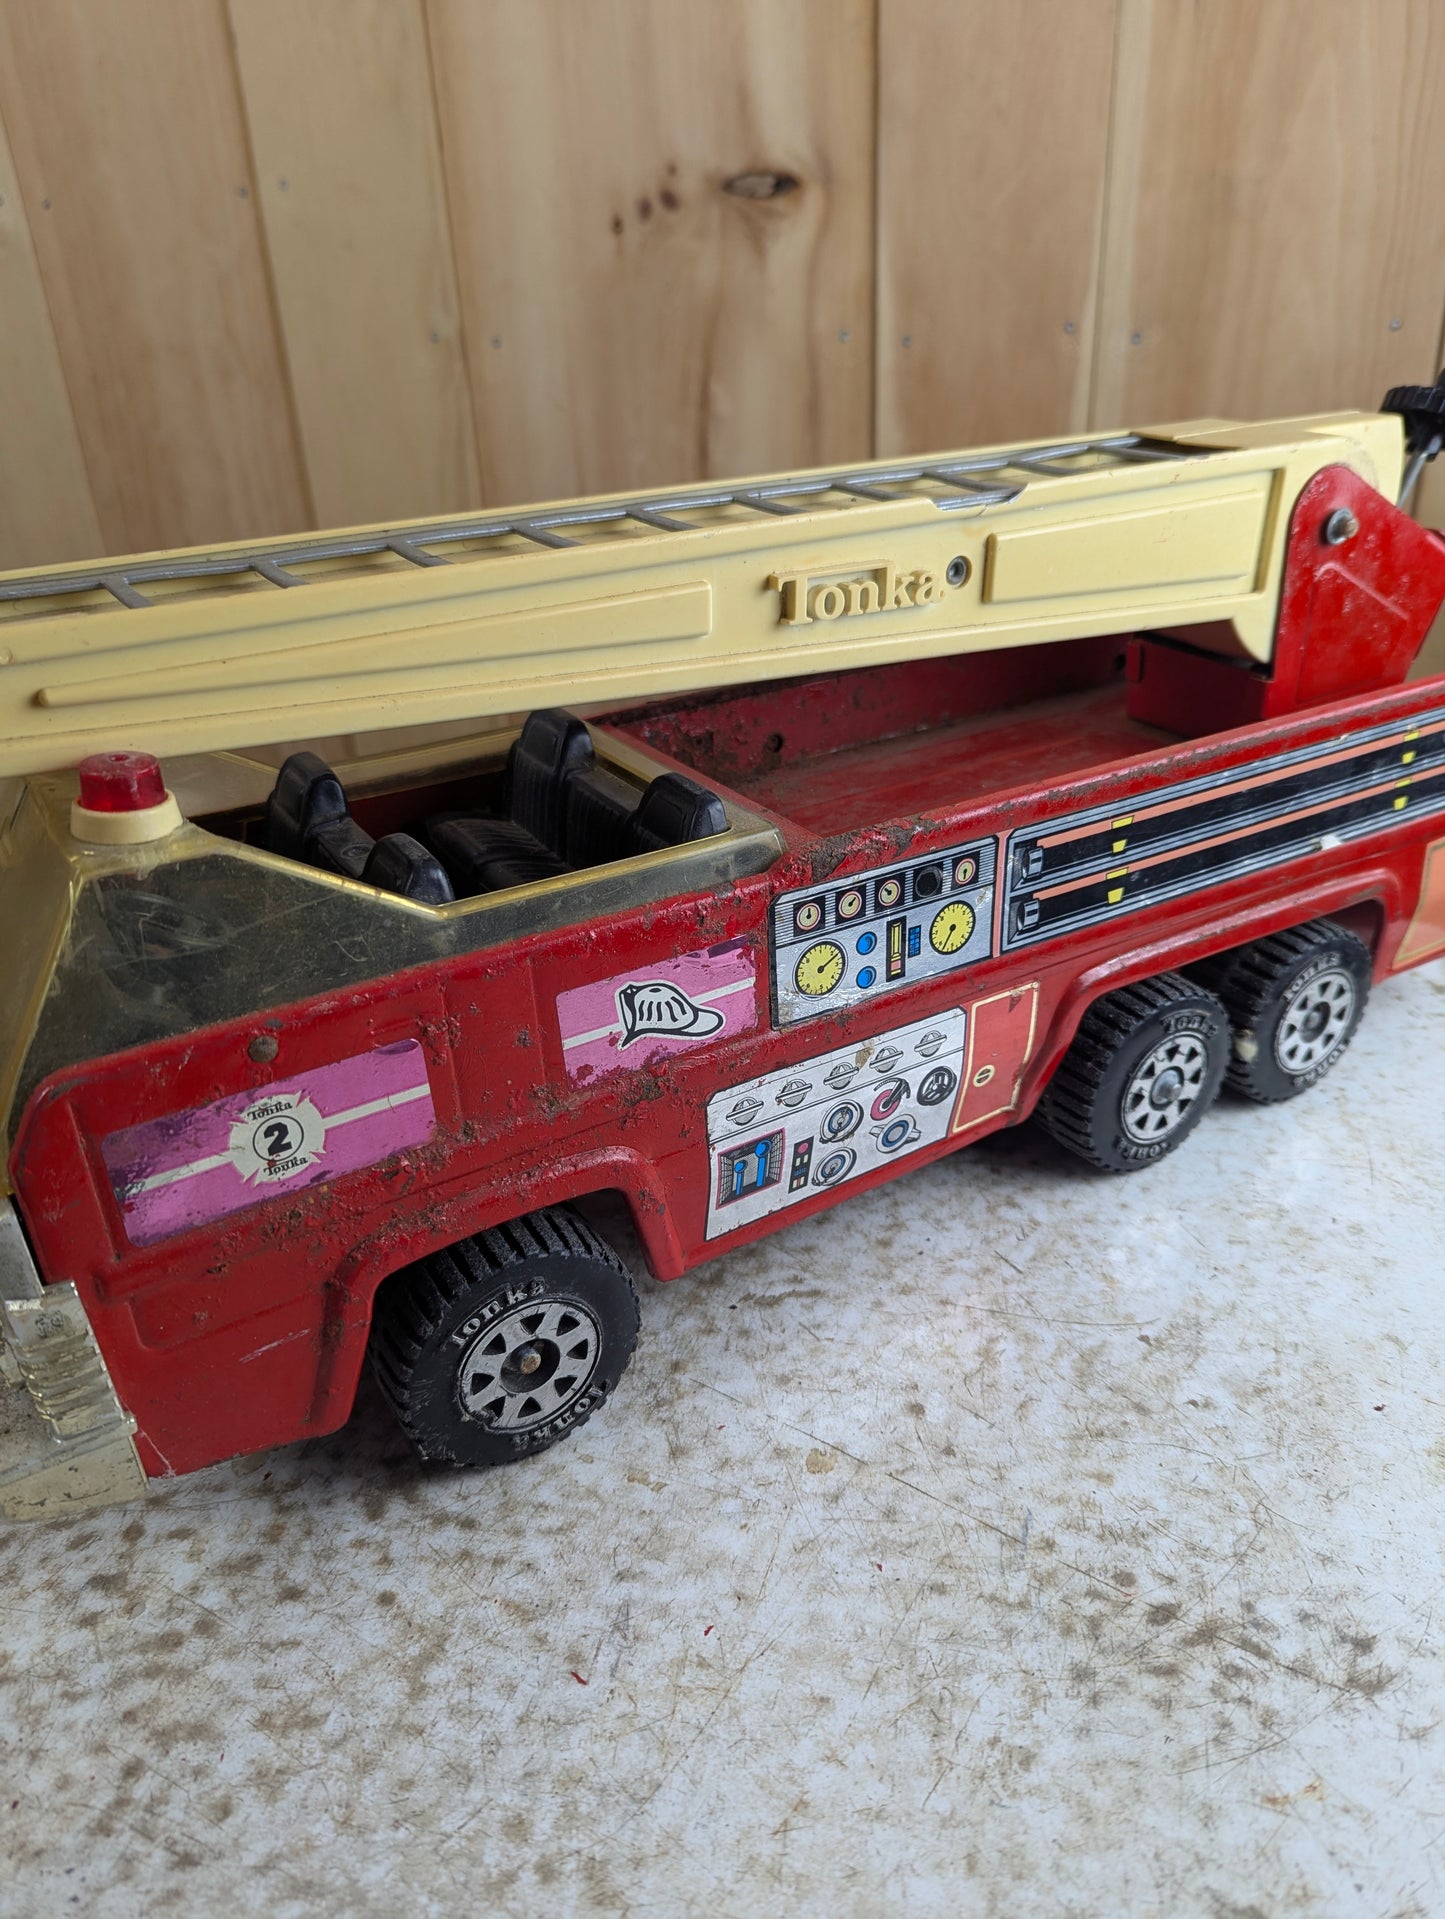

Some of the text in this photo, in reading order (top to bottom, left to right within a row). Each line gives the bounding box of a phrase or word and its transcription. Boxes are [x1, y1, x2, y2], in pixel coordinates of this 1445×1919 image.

[766, 558, 945, 626] Tonka
[246, 1101, 293, 1121] Tonka
[263, 1121, 293, 1156] 2
[263, 1156, 309, 1177] Tonka
